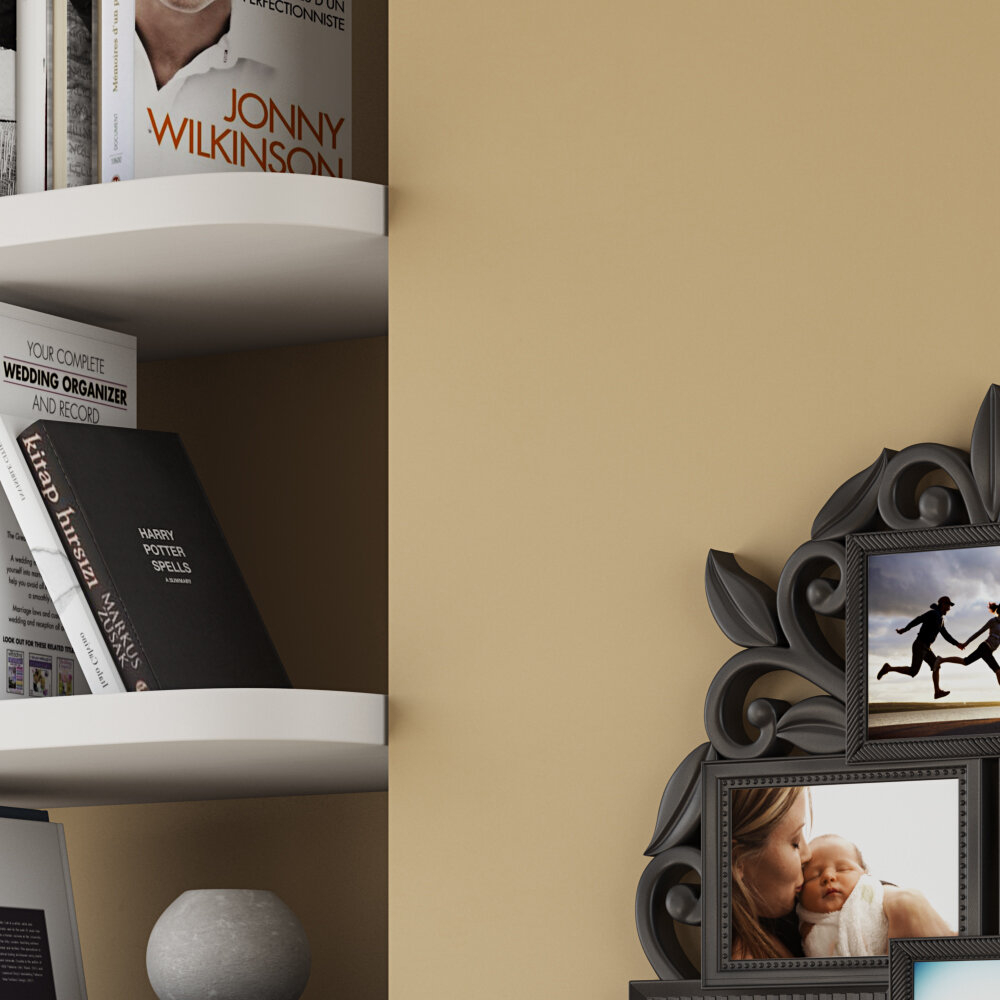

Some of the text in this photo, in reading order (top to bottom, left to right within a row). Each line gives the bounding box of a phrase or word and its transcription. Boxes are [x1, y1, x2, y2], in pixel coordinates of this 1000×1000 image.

[224, 88, 345, 150] JONNY
[147, 107, 344, 178] WILKINSON
[27, 340, 104, 374] YOUR COMPLETE
[3, 361, 127, 406] WEDDING ORGANIZER
[32, 394, 99, 424] AND RECORD
[22, 432, 59, 503] kitap
[138, 528, 174, 541] HARRY
[143, 543, 186, 557] POTTER
[151, 560, 192, 573] SPELLS
[3, 635, 15, 644] LOOK
[15, 637, 25, 645] OUT
[25, 639, 34, 647] FOR
[34, 641, 47, 649] THESE
[98, 606, 129, 668] ZUSAK
[102, 592, 142, 669] MARKUS
